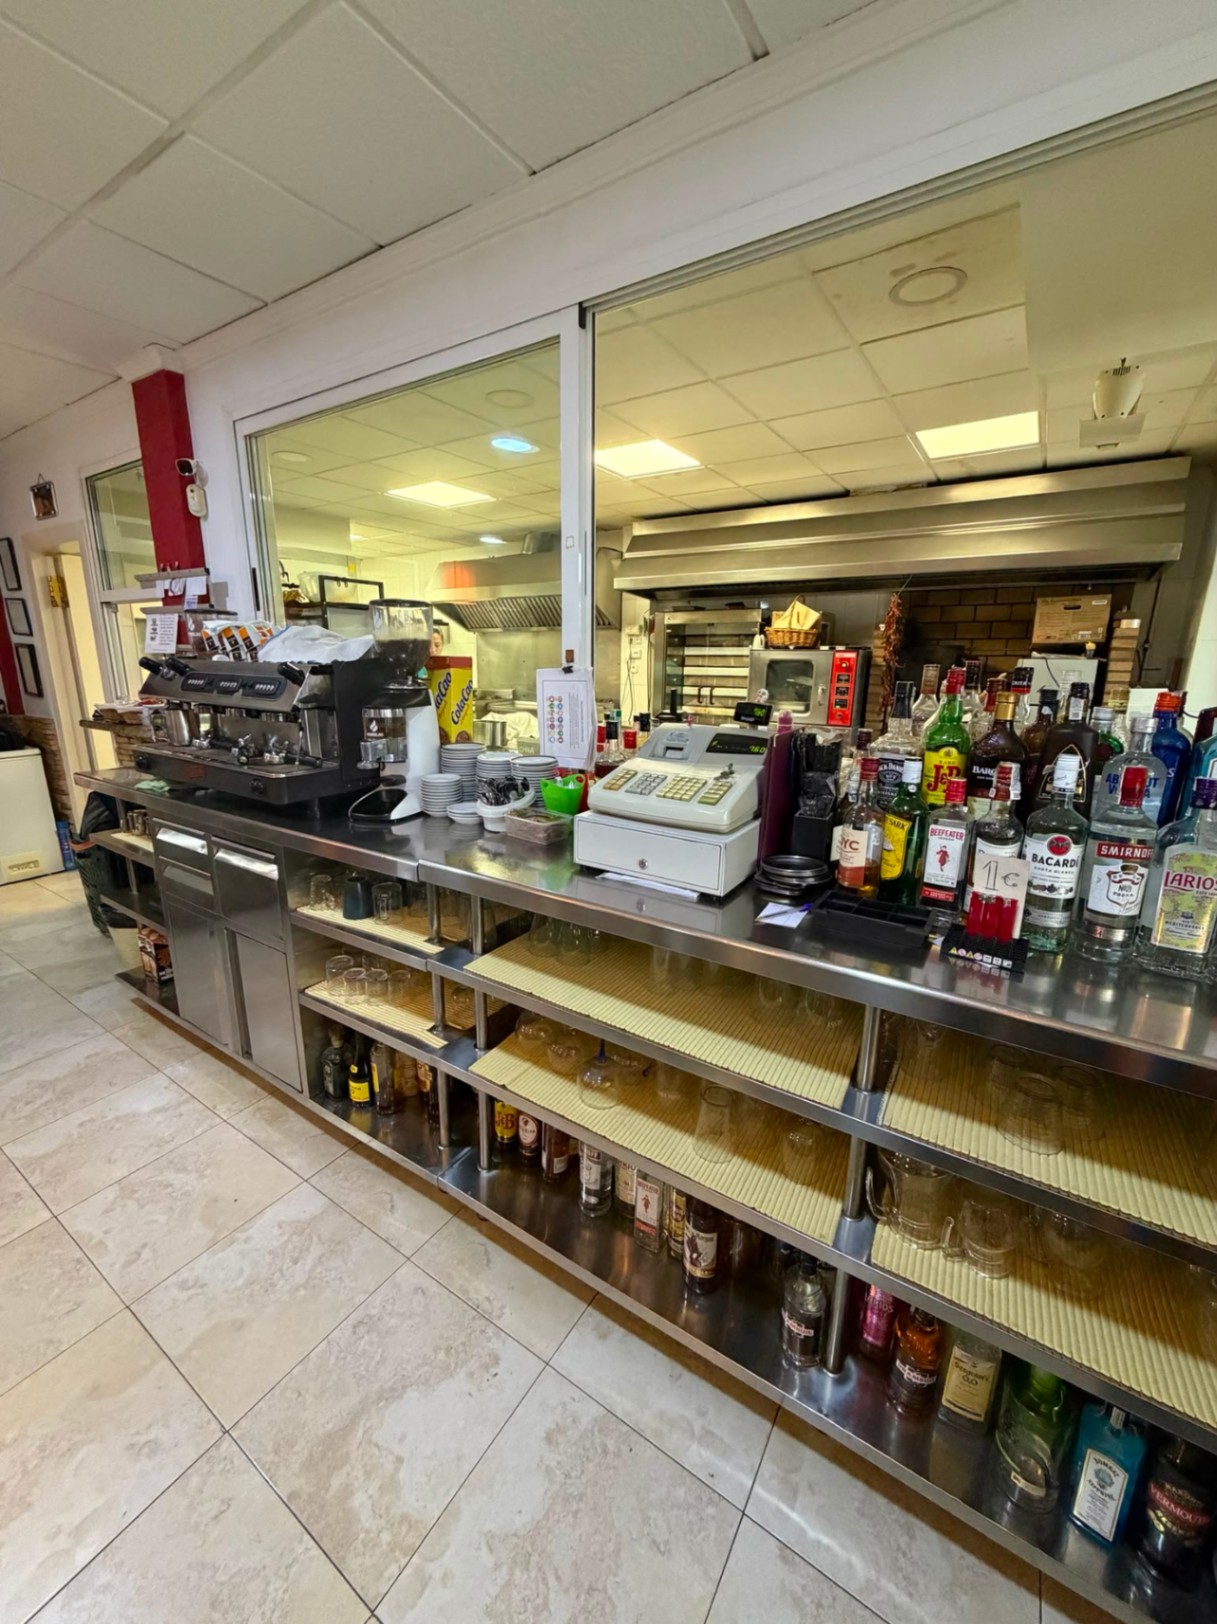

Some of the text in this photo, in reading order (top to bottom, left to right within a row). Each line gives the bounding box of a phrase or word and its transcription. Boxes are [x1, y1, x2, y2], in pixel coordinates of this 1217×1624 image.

[435, 672, 452, 709] laCao
[451, 680, 473, 726] ColaCao
[972, 765, 996, 777] BARC
[929, 827, 964, 841] BEEFEATER
